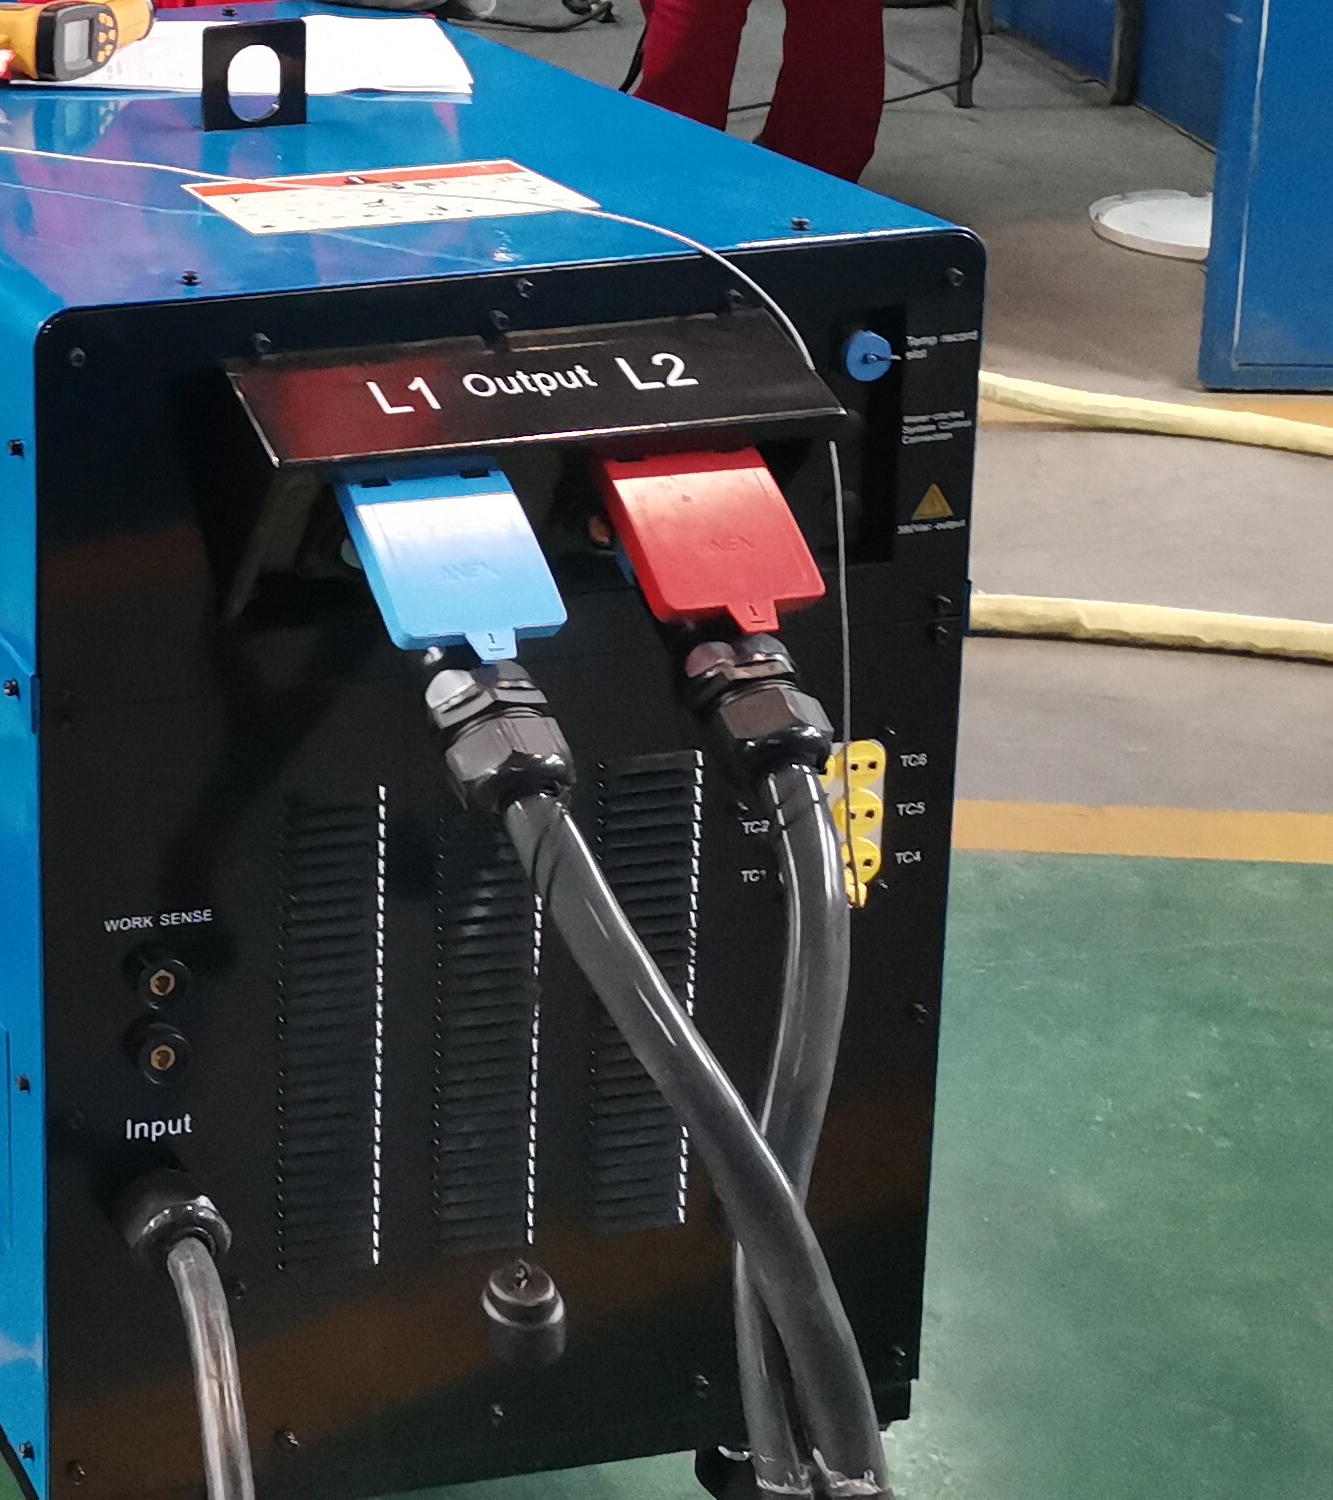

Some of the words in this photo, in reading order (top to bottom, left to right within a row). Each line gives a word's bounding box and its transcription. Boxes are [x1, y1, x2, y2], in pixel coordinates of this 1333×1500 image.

[366, 376, 441, 415] L1
[462, 364, 598, 397] Output
[615, 352, 699, 391] L2
[103, 915, 154, 933] WORK
[159, 908, 213, 927] SENSE
[126, 1112, 193, 1142] Input
